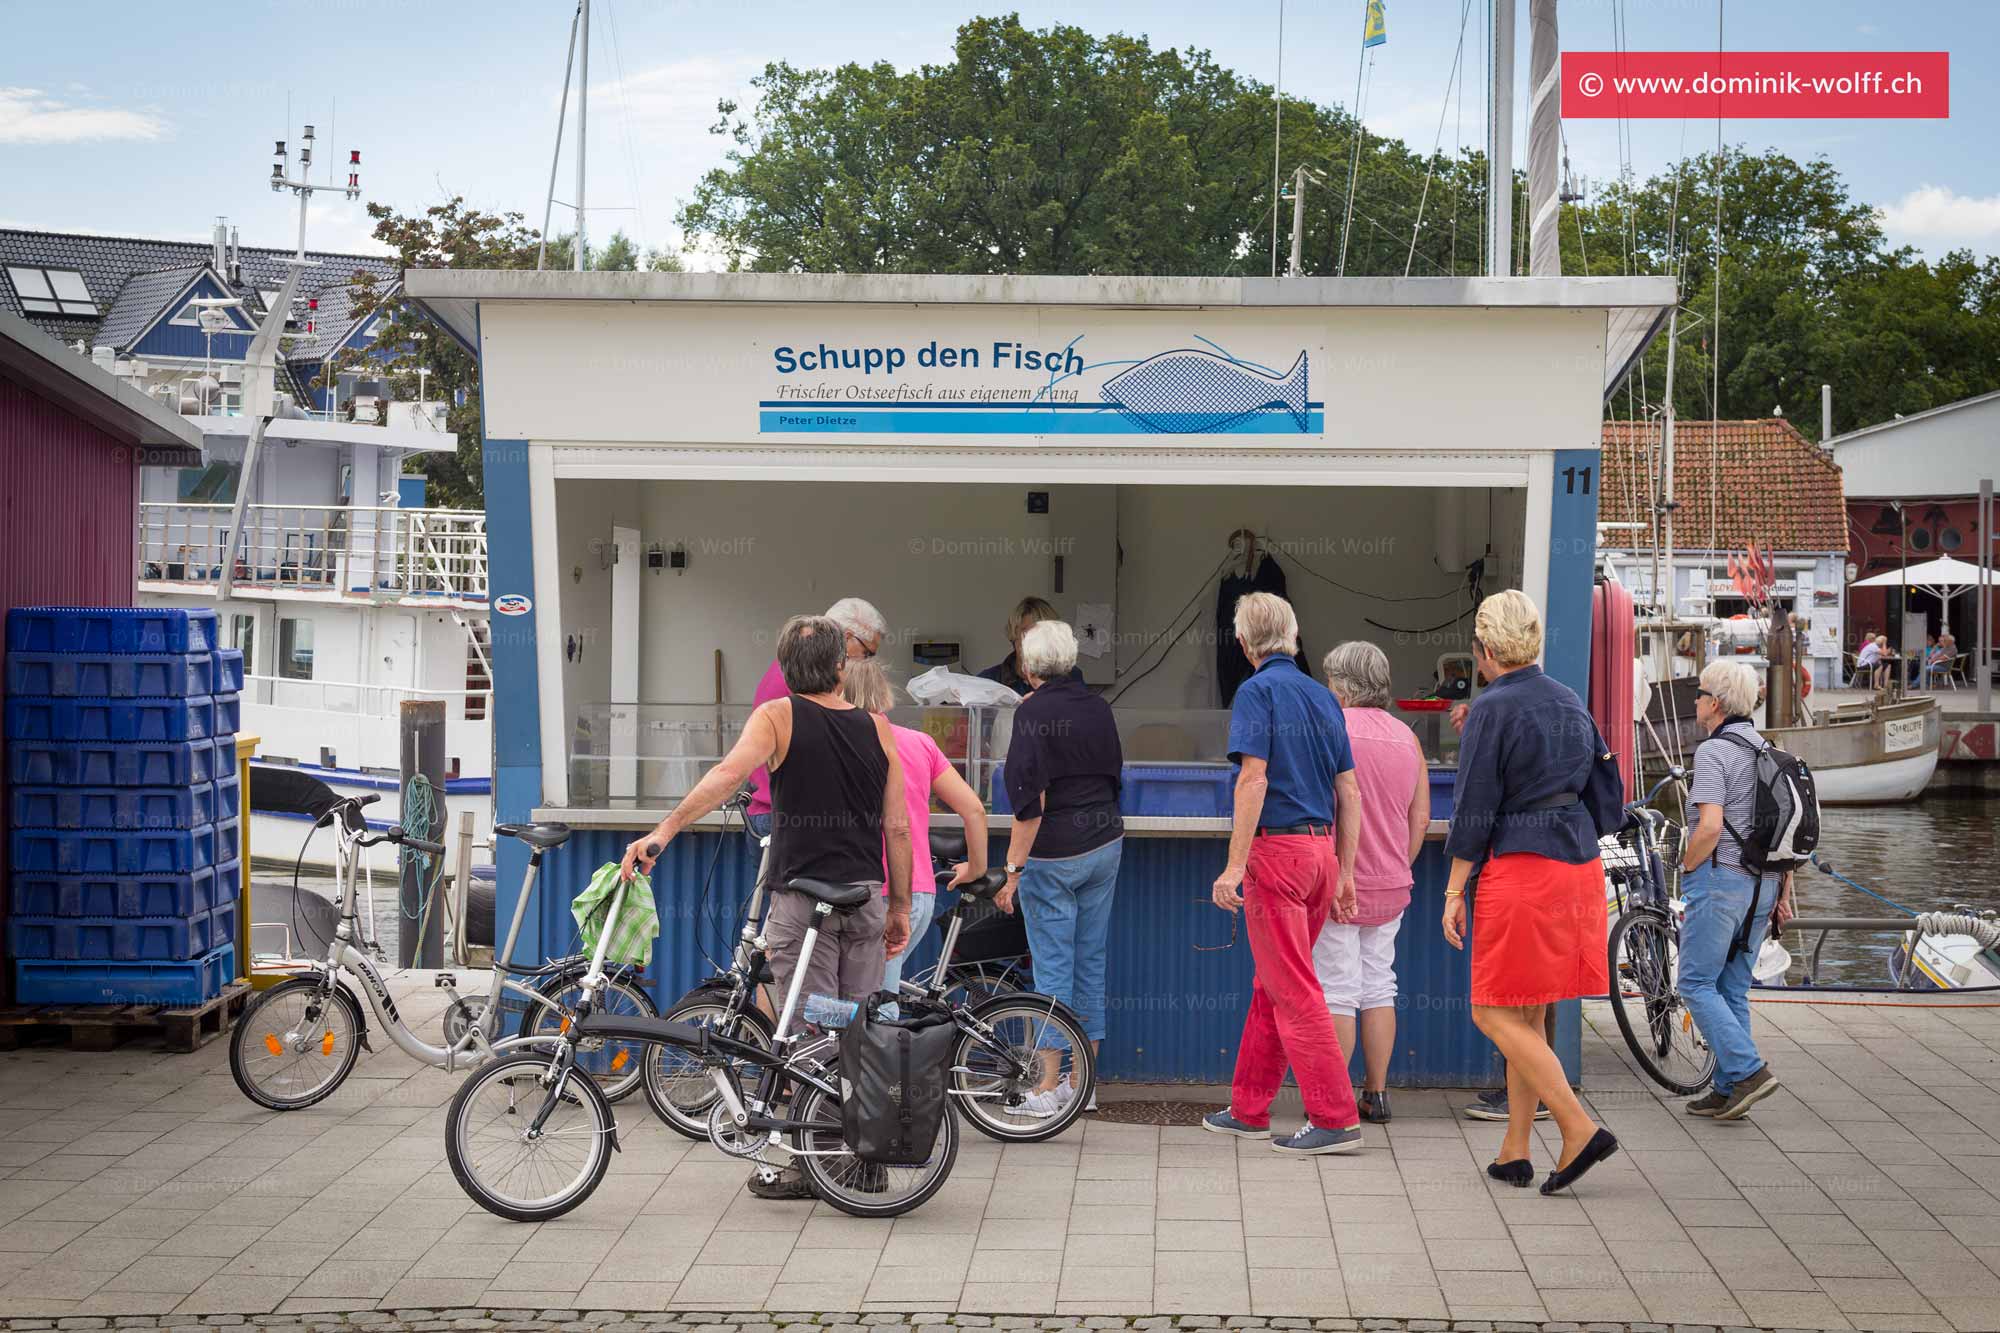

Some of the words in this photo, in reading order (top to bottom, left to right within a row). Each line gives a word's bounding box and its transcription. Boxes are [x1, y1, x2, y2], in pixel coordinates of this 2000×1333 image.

[774, 343, 906, 374] Schupp
[917, 341, 982, 368] den
[993, 342, 1084, 375] Fisch
[776, 383, 842, 400] Frischer
[845, 383, 933, 402] Ostseefisch
[938, 387, 965, 400] aus
[969, 384, 1031, 402] eigenem
[1036, 384, 1078, 402] Fang
[779, 415, 812, 426] Peter
[816, 415, 857, 426] Dietze
[1562, 466, 1592, 494] 11
[357, 962, 384, 998] DAHON
